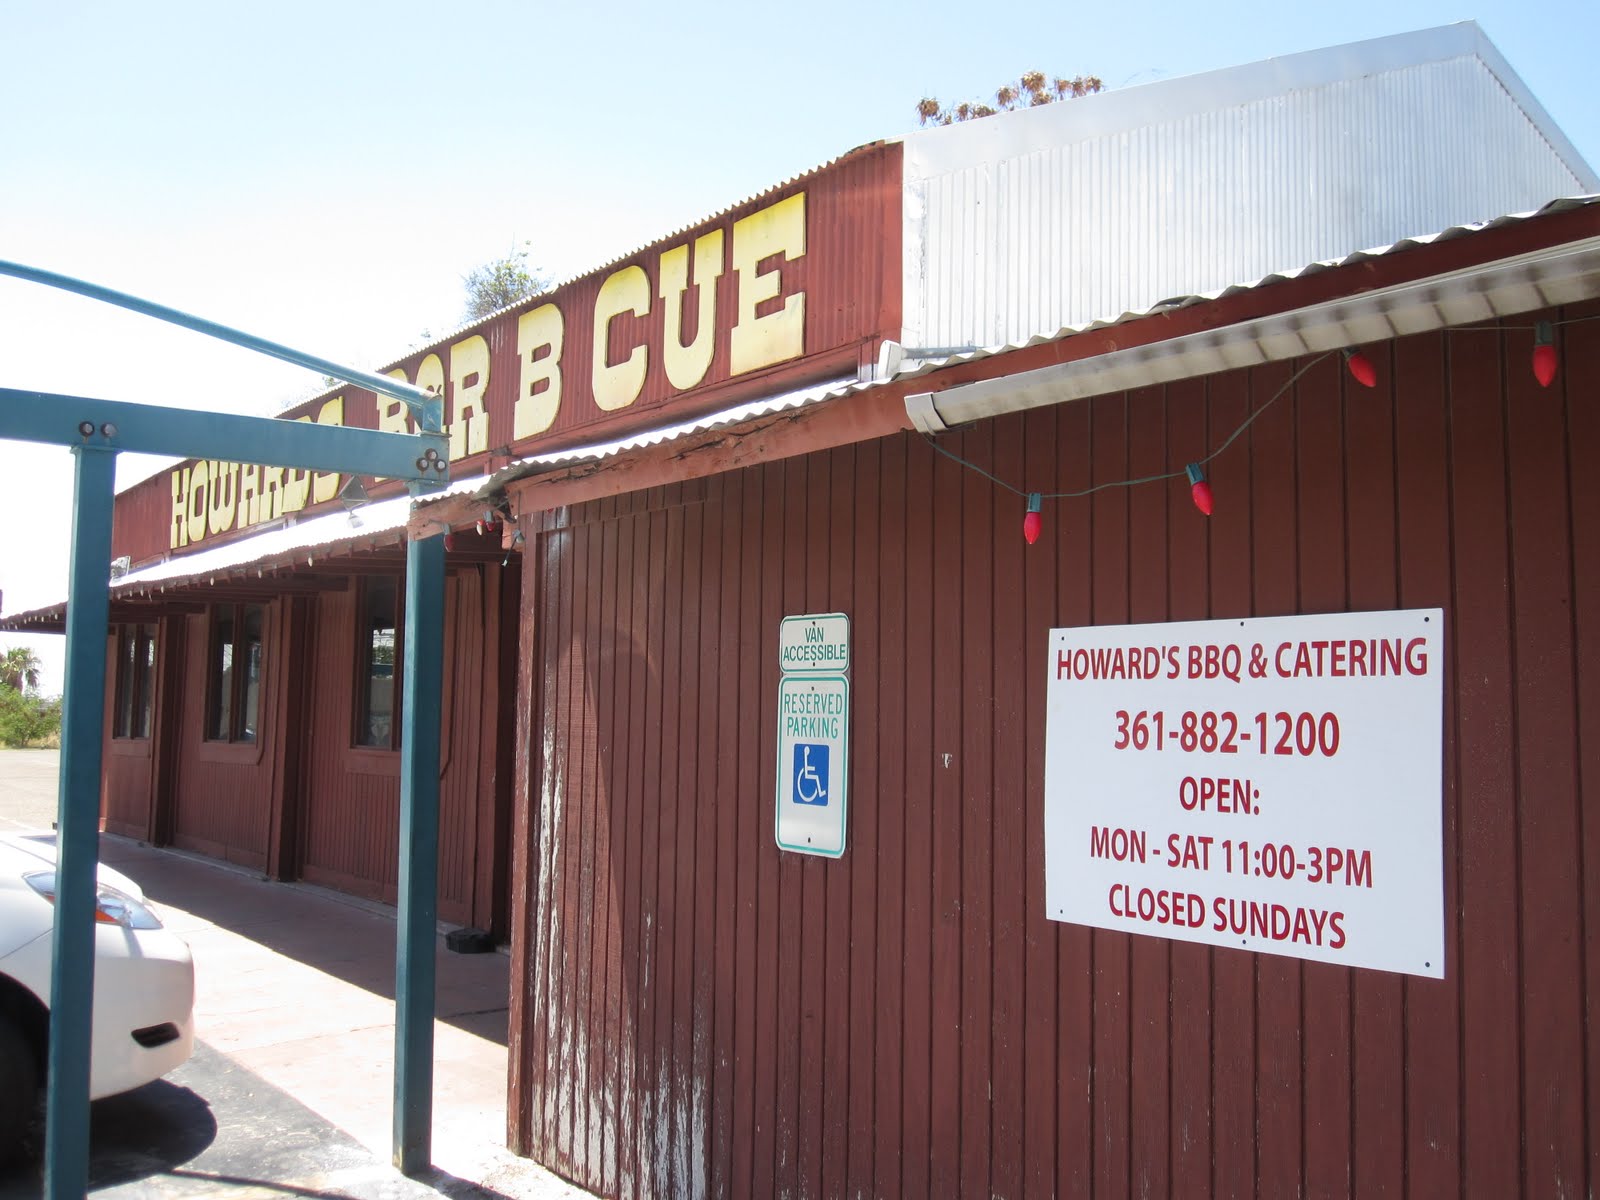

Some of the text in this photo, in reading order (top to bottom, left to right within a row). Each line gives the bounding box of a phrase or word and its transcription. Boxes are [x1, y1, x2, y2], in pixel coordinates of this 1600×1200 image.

[513, 303, 565, 441] B
[592, 191, 807, 412] CUE
[783, 644, 847, 661] ACCESSIBLE
[805, 627, 824, 643] VAN
[1057, 637, 1428, 683] HOWARD'S BBQ & CATERING
[784, 693, 843, 715] RESERVED
[787, 716, 839, 740] PARKING
[1114, 710, 1340, 757] 361-882-1200
[1179, 776, 1261, 815] OPEN:
[1091, 826, 1146, 864] MON
[1167, 833, 1214, 872] SAT
[1222, 838, 1372, 888] 11:00-3PM
[1109, 883, 1346, 949] CLOSED SUNDAYS
